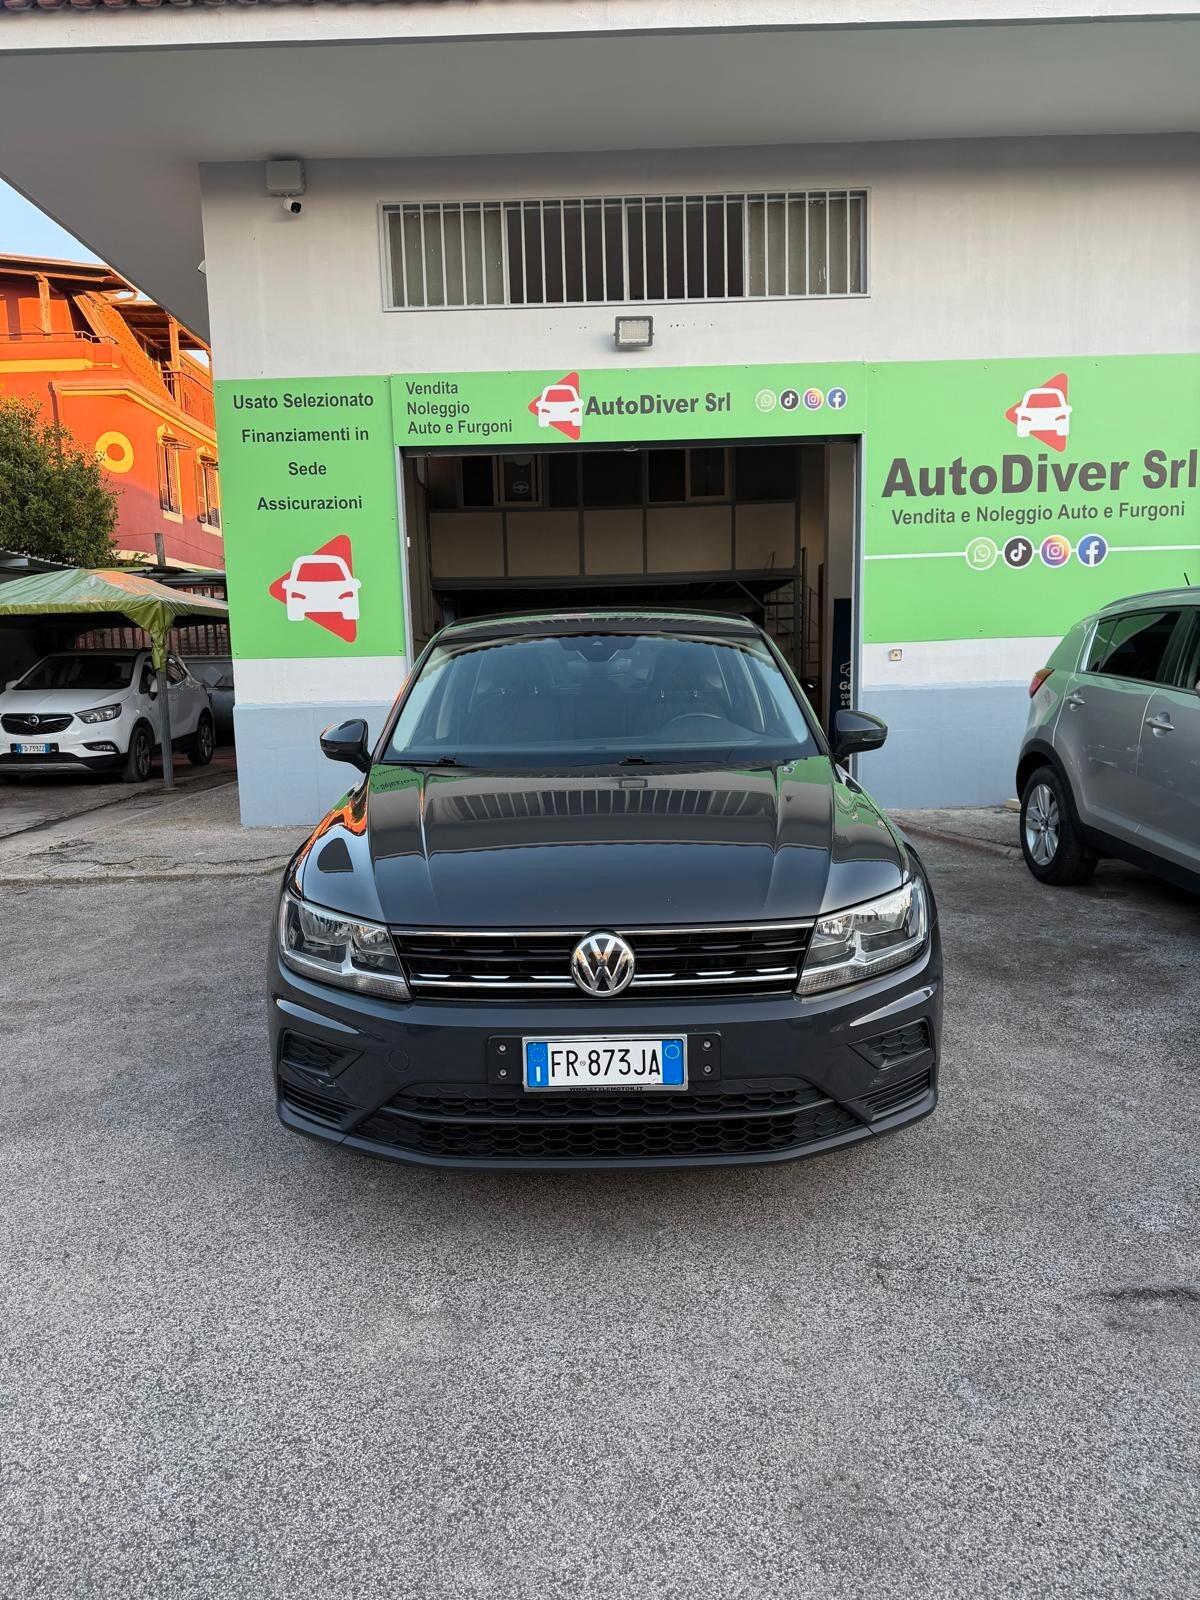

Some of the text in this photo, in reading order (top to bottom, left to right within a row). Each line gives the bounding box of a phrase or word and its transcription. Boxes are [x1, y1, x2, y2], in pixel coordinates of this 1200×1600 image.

[405, 380, 459, 396] Vendita
[233, 392, 374, 410] Usato Selezionato
[406, 401, 470, 419] Noleggio
[585, 391, 732, 416] AutoDiver Srl
[241, 426, 369, 443] Finanziamenti in
[408, 418, 513, 437] Auto e Furgoni
[288, 461, 327, 476] Sede
[881, 448, 1199, 498] AutoDiver Srl
[256, 495, 363, 511] Assicurazioni
[891, 500, 1185, 526] Vendita e Noleggio Auto e Furgoni
